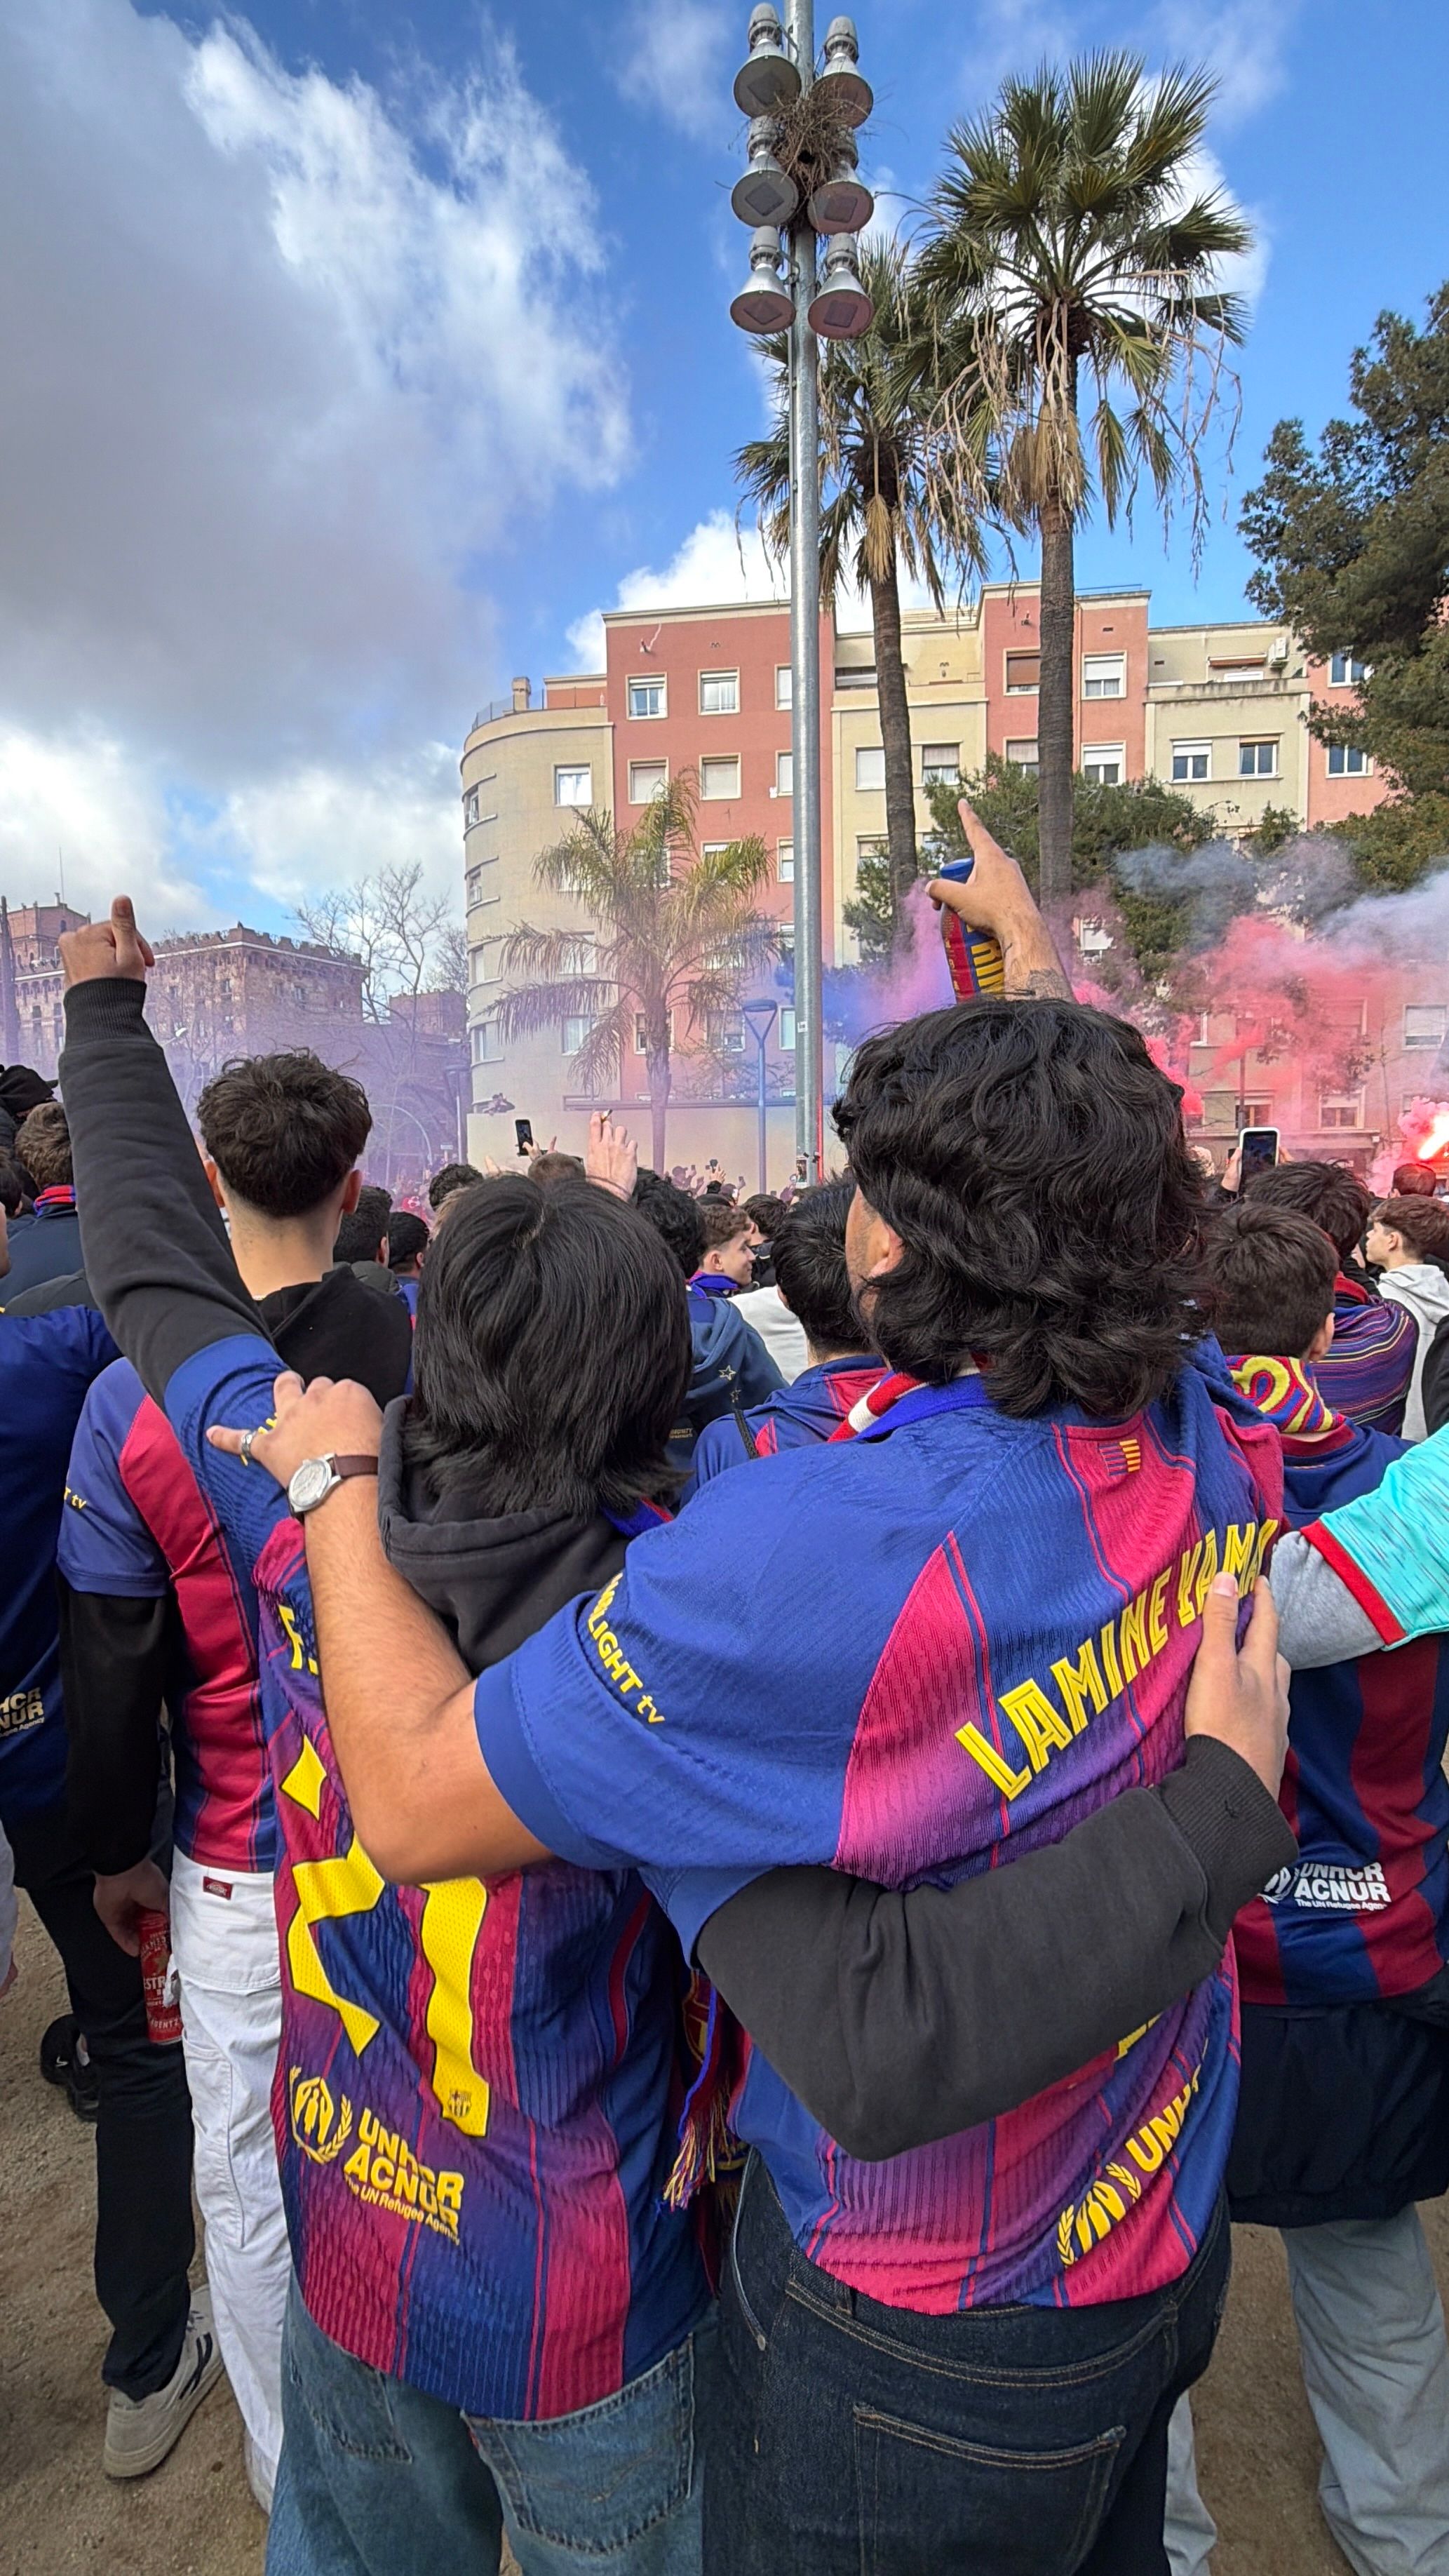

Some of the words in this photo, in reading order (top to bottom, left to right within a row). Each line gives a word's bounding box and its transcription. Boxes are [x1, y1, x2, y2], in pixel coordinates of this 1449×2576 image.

[955, 1567, 1172, 1802] LAMINE
[1178, 1519, 1279, 1628] YAMA
[0, 1686, 41, 1714] HCR
[0, 1700, 44, 1729] NUR
[637, 1694, 666, 1724] tv
[1294, 1878, 1392, 1903] ACNUR
[360, 2185, 379, 2205] UN
[379, 2192, 424, 2222] Refugee
